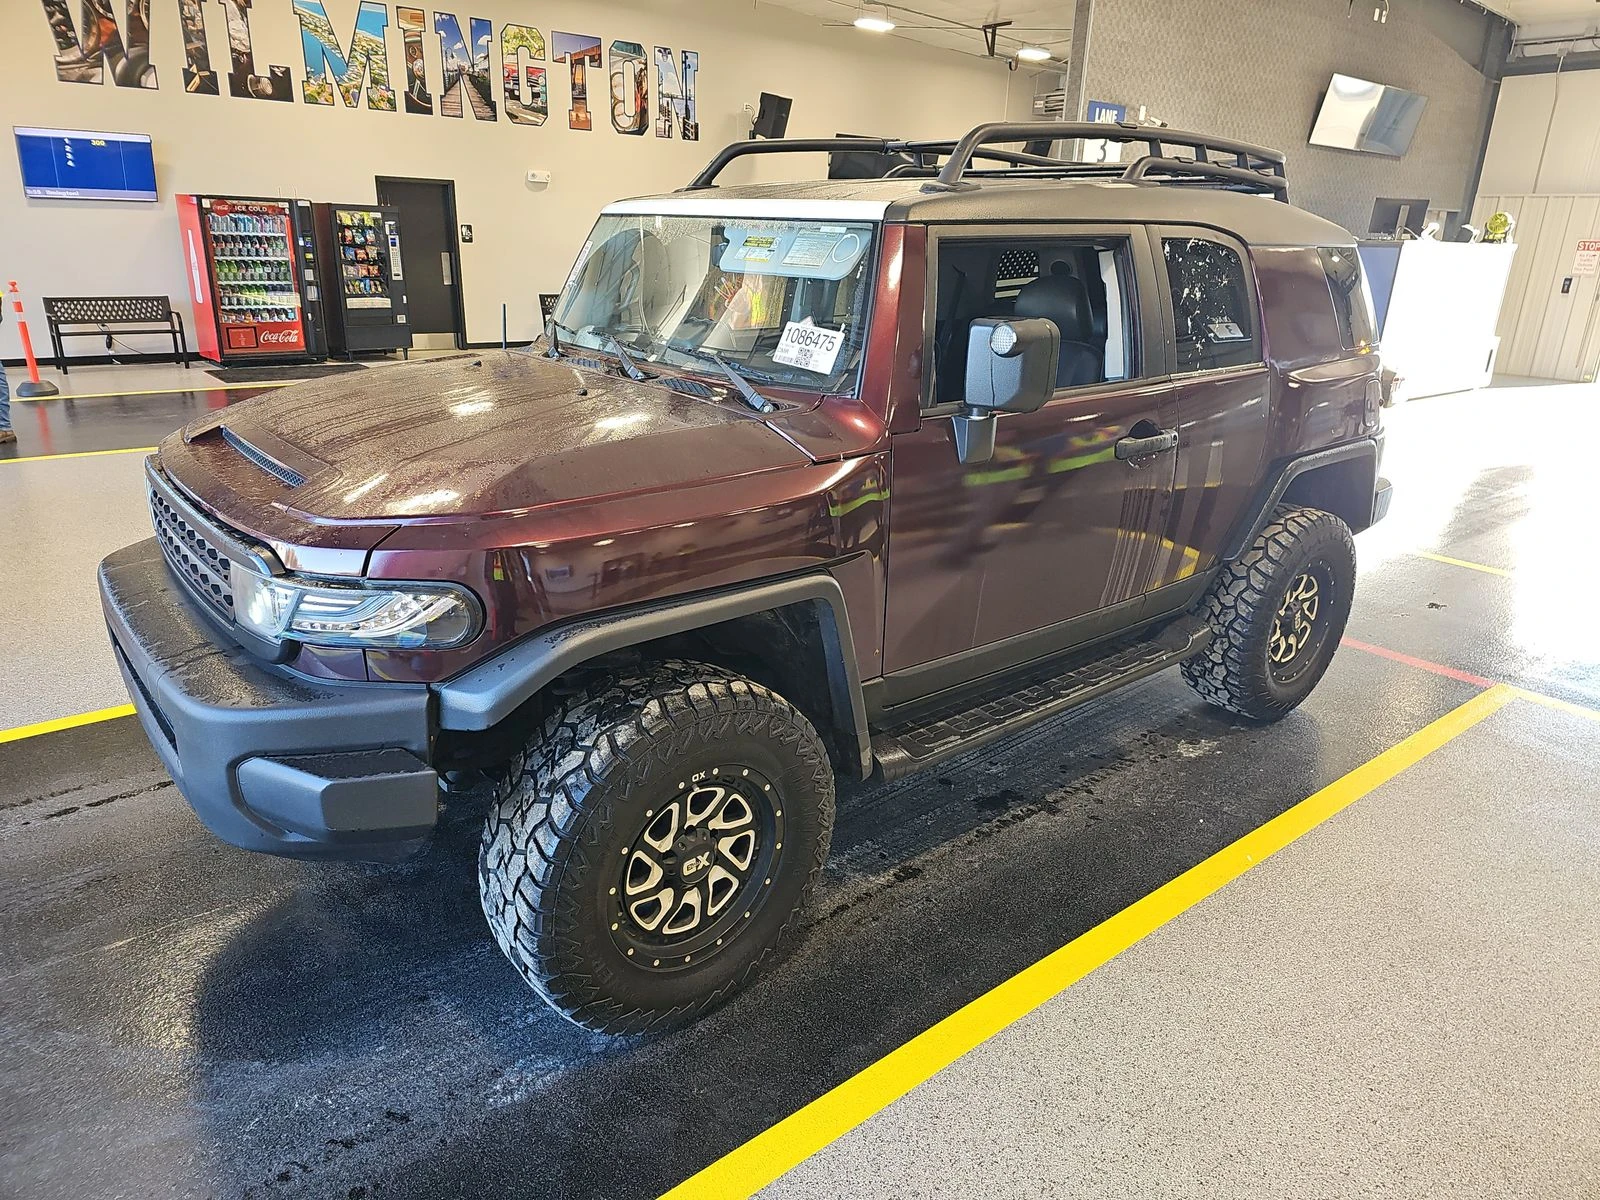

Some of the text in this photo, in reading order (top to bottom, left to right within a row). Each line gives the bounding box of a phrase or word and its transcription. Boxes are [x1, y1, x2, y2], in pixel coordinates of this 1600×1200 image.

[42, 0, 700, 141] WILMINGTON
[1094, 107, 1118, 124] LANE
[90, 139, 106, 147] 300
[1096, 139, 1108, 163] 3
[248, 205, 268, 213] COLD
[1577, 242, 1600, 251] STOP
[260, 329, 299, 344] Coca-Cola
[785, 326, 837, 352] 1086475
